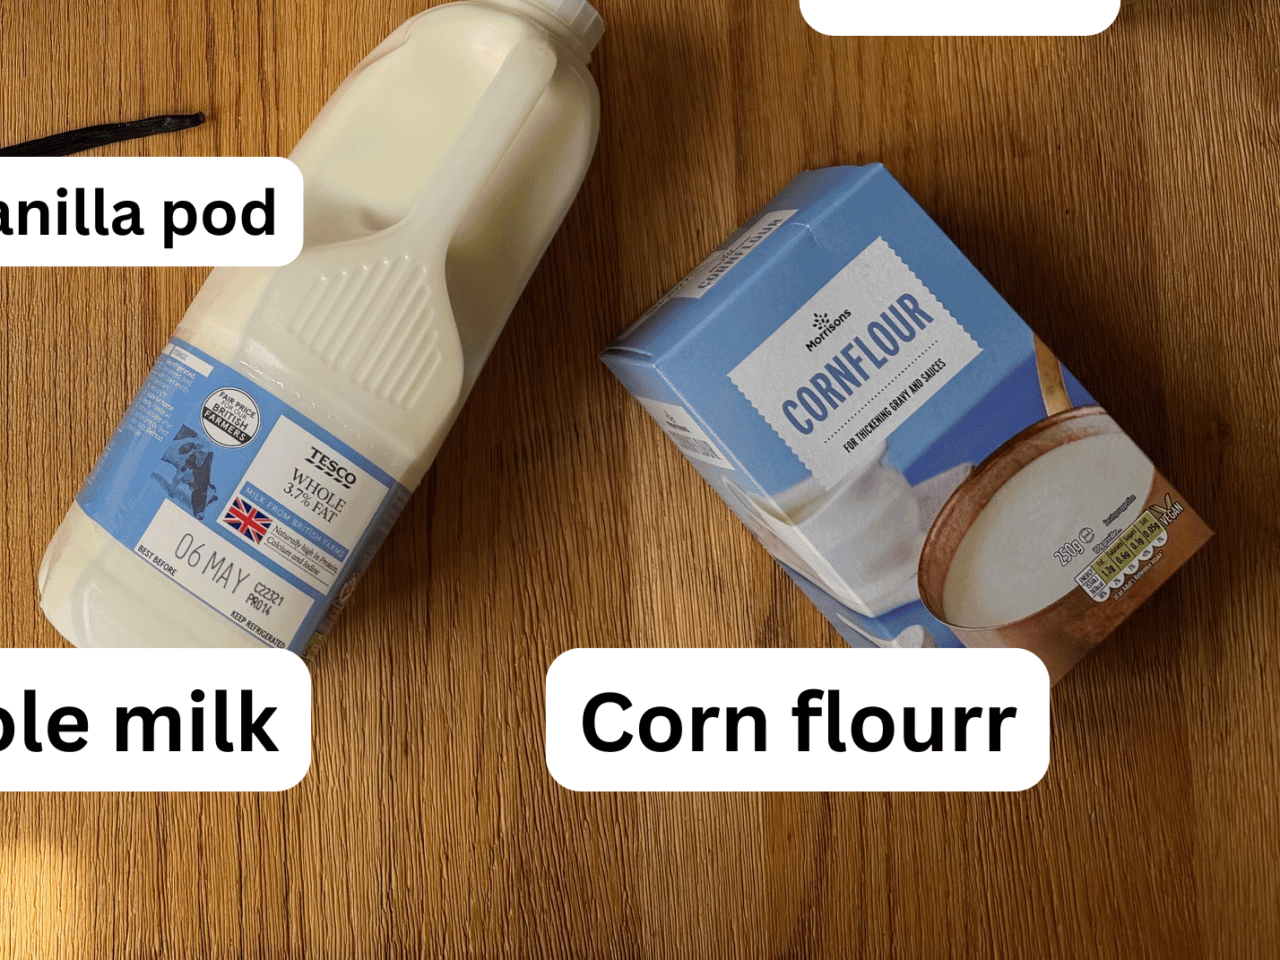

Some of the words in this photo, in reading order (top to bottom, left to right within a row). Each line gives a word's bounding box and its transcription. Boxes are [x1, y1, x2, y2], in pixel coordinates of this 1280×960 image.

[695, 215, 783, 291] CORNFLOUR
[804, 308, 852, 351] Morrisons
[775, 285, 934, 438] CORNFLOUR
[212, 402, 248, 430] BRITISH
[218, 391, 234, 404] FAIR
[234, 401, 256, 418] PRICE
[220, 399, 233, 410] FOR
[842, 437, 858, 453] FOR
[854, 406, 892, 442] THICKENING
[888, 388, 911, 411] GRAVY
[907, 377, 924, 394] AND
[920, 357, 946, 382] SAUCES
[203, 409, 246, 441] FARMERS
[306, 445, 358, 486] TESCO
[282, 481, 313, 507] 3.7%
[310, 500, 338, 523] FAT
[288, 467, 347, 512] WHOLE
[243, 486, 266, 504] MILK
[265, 501, 291, 521] FROM
[290, 518, 322, 542] BRITISH
[1141, 520, 1161, 538] 0.05g
[1159, 500, 1184, 526] VEGAN
[265, 535, 292, 556] Calcium
[290, 552, 304, 565] and
[272, 524, 302, 548] Naturally
[300, 543, 315, 558] high
[1051, 535, 1086, 569] 250g
[1114, 548, 1131, 565] 0.6g
[1129, 535, 1145, 551] 0.1g
[137, 544, 154, 560] BEST
[152, 555, 177, 576] BEFORE
[171, 531, 209, 569] 06
[200, 550, 251, 596] MAY
[1100, 563, 1116, 578] 1.2g
[230, 609, 246, 624] KEEP
[244, 619, 285, 650] REFRIGERATED
